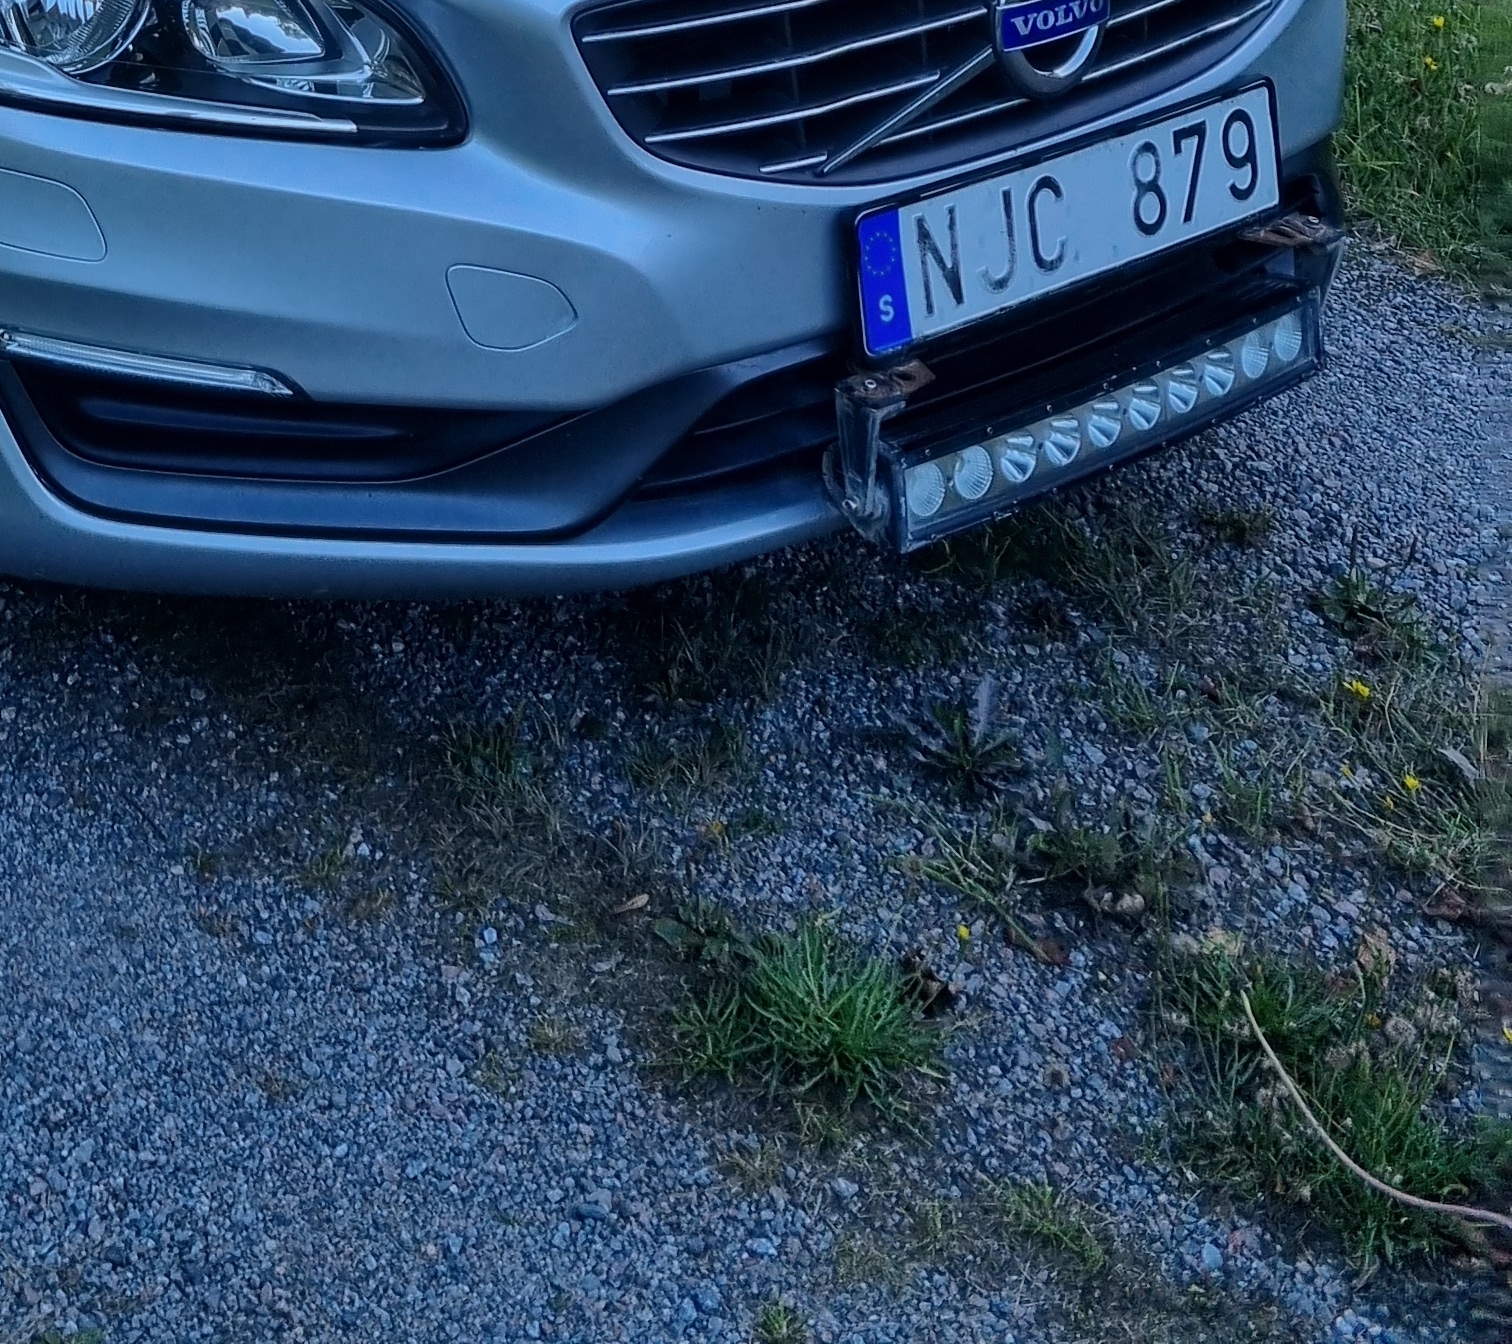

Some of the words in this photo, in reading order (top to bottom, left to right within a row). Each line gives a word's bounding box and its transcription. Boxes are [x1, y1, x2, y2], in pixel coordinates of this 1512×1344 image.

[913, 175, 1068, 317] NJC
[1128, 108, 1261, 236] 879
[878, 295, 895, 322] S
